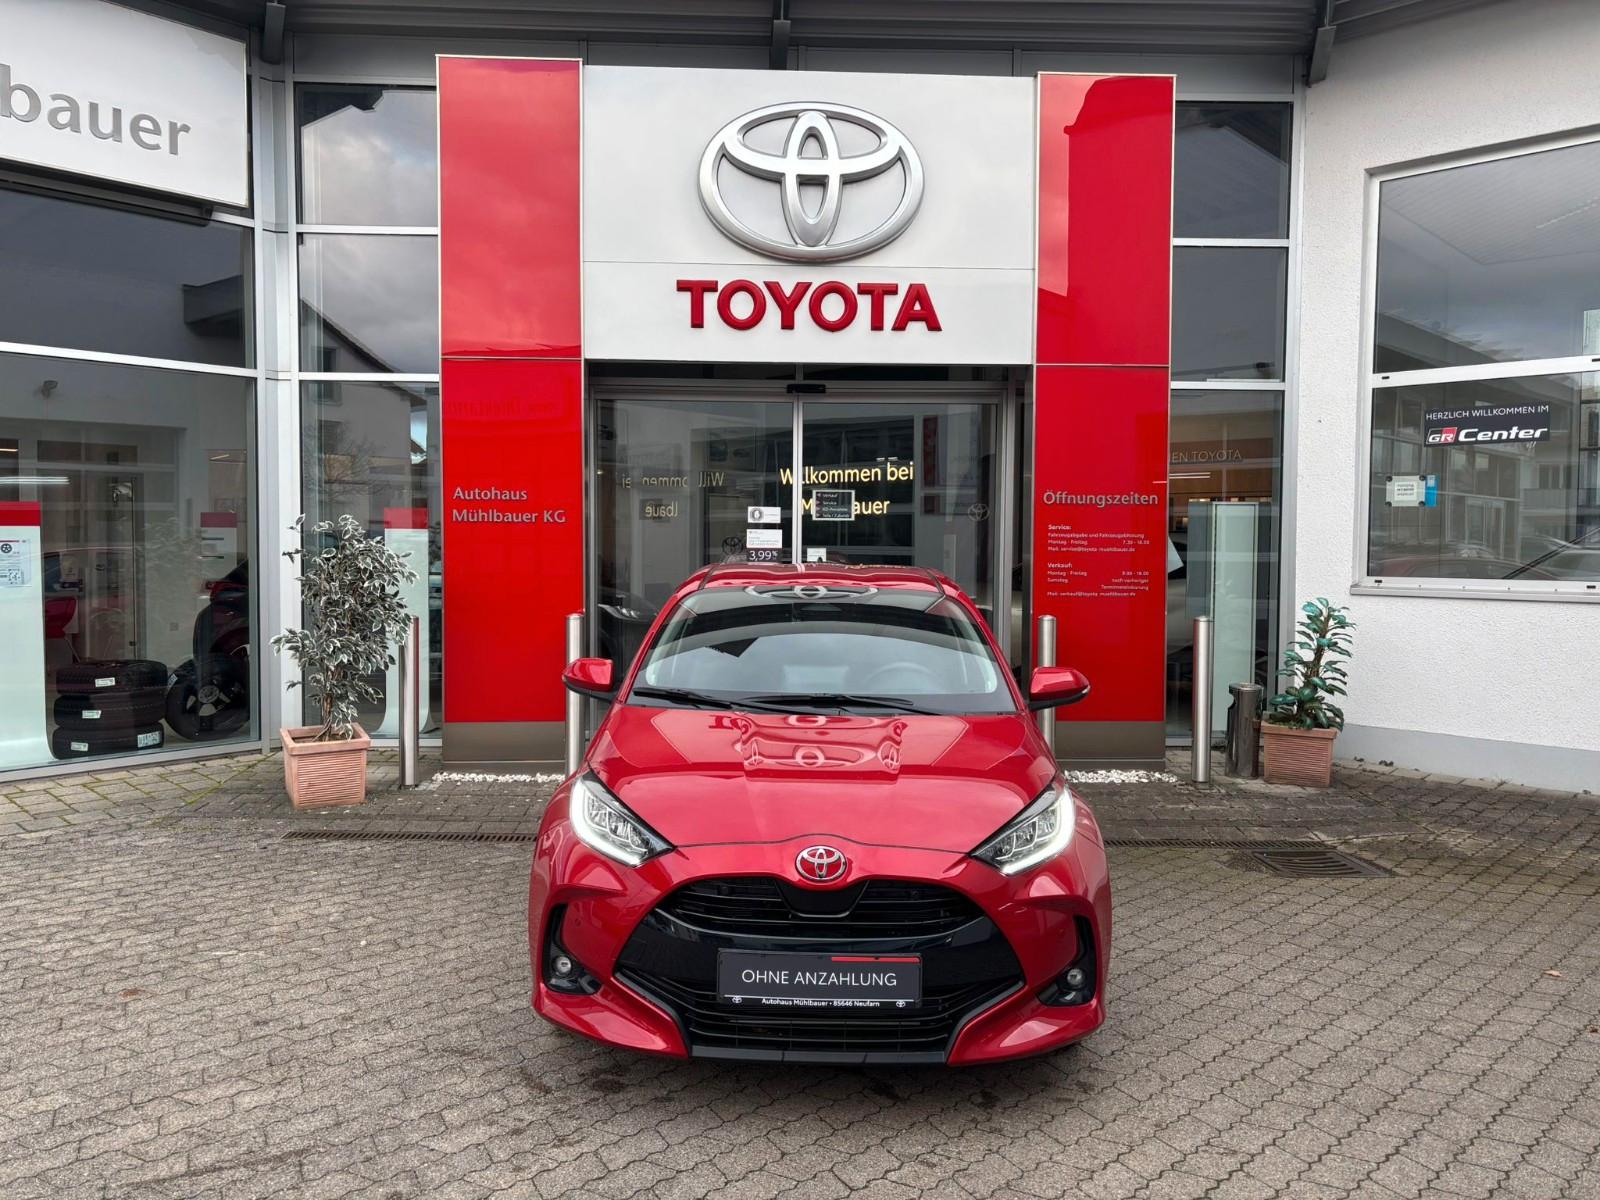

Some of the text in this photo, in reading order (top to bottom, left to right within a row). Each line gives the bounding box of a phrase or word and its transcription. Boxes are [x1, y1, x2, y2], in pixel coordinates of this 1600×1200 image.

[676, 279, 943, 332] TOYOTA
[1426, 404, 1549, 420] HERZLICH WILLKOMMEN IM
[1427, 426, 1549, 444] GR Center
[1192, 449, 1242, 463] TOYOTA
[780, 461, 914, 485] Wlkommen bei
[452, 487, 528, 501] Autohaus
[1043, 489, 1159, 508] Öffnungszeiten
[452, 509, 566, 523] Mühlbauer KG
[741, 969, 897, 987] OHNE ANZAHLUNG
[761, 998, 880, 1007] Autohaus Mühlbauer 85646 Neufarn
